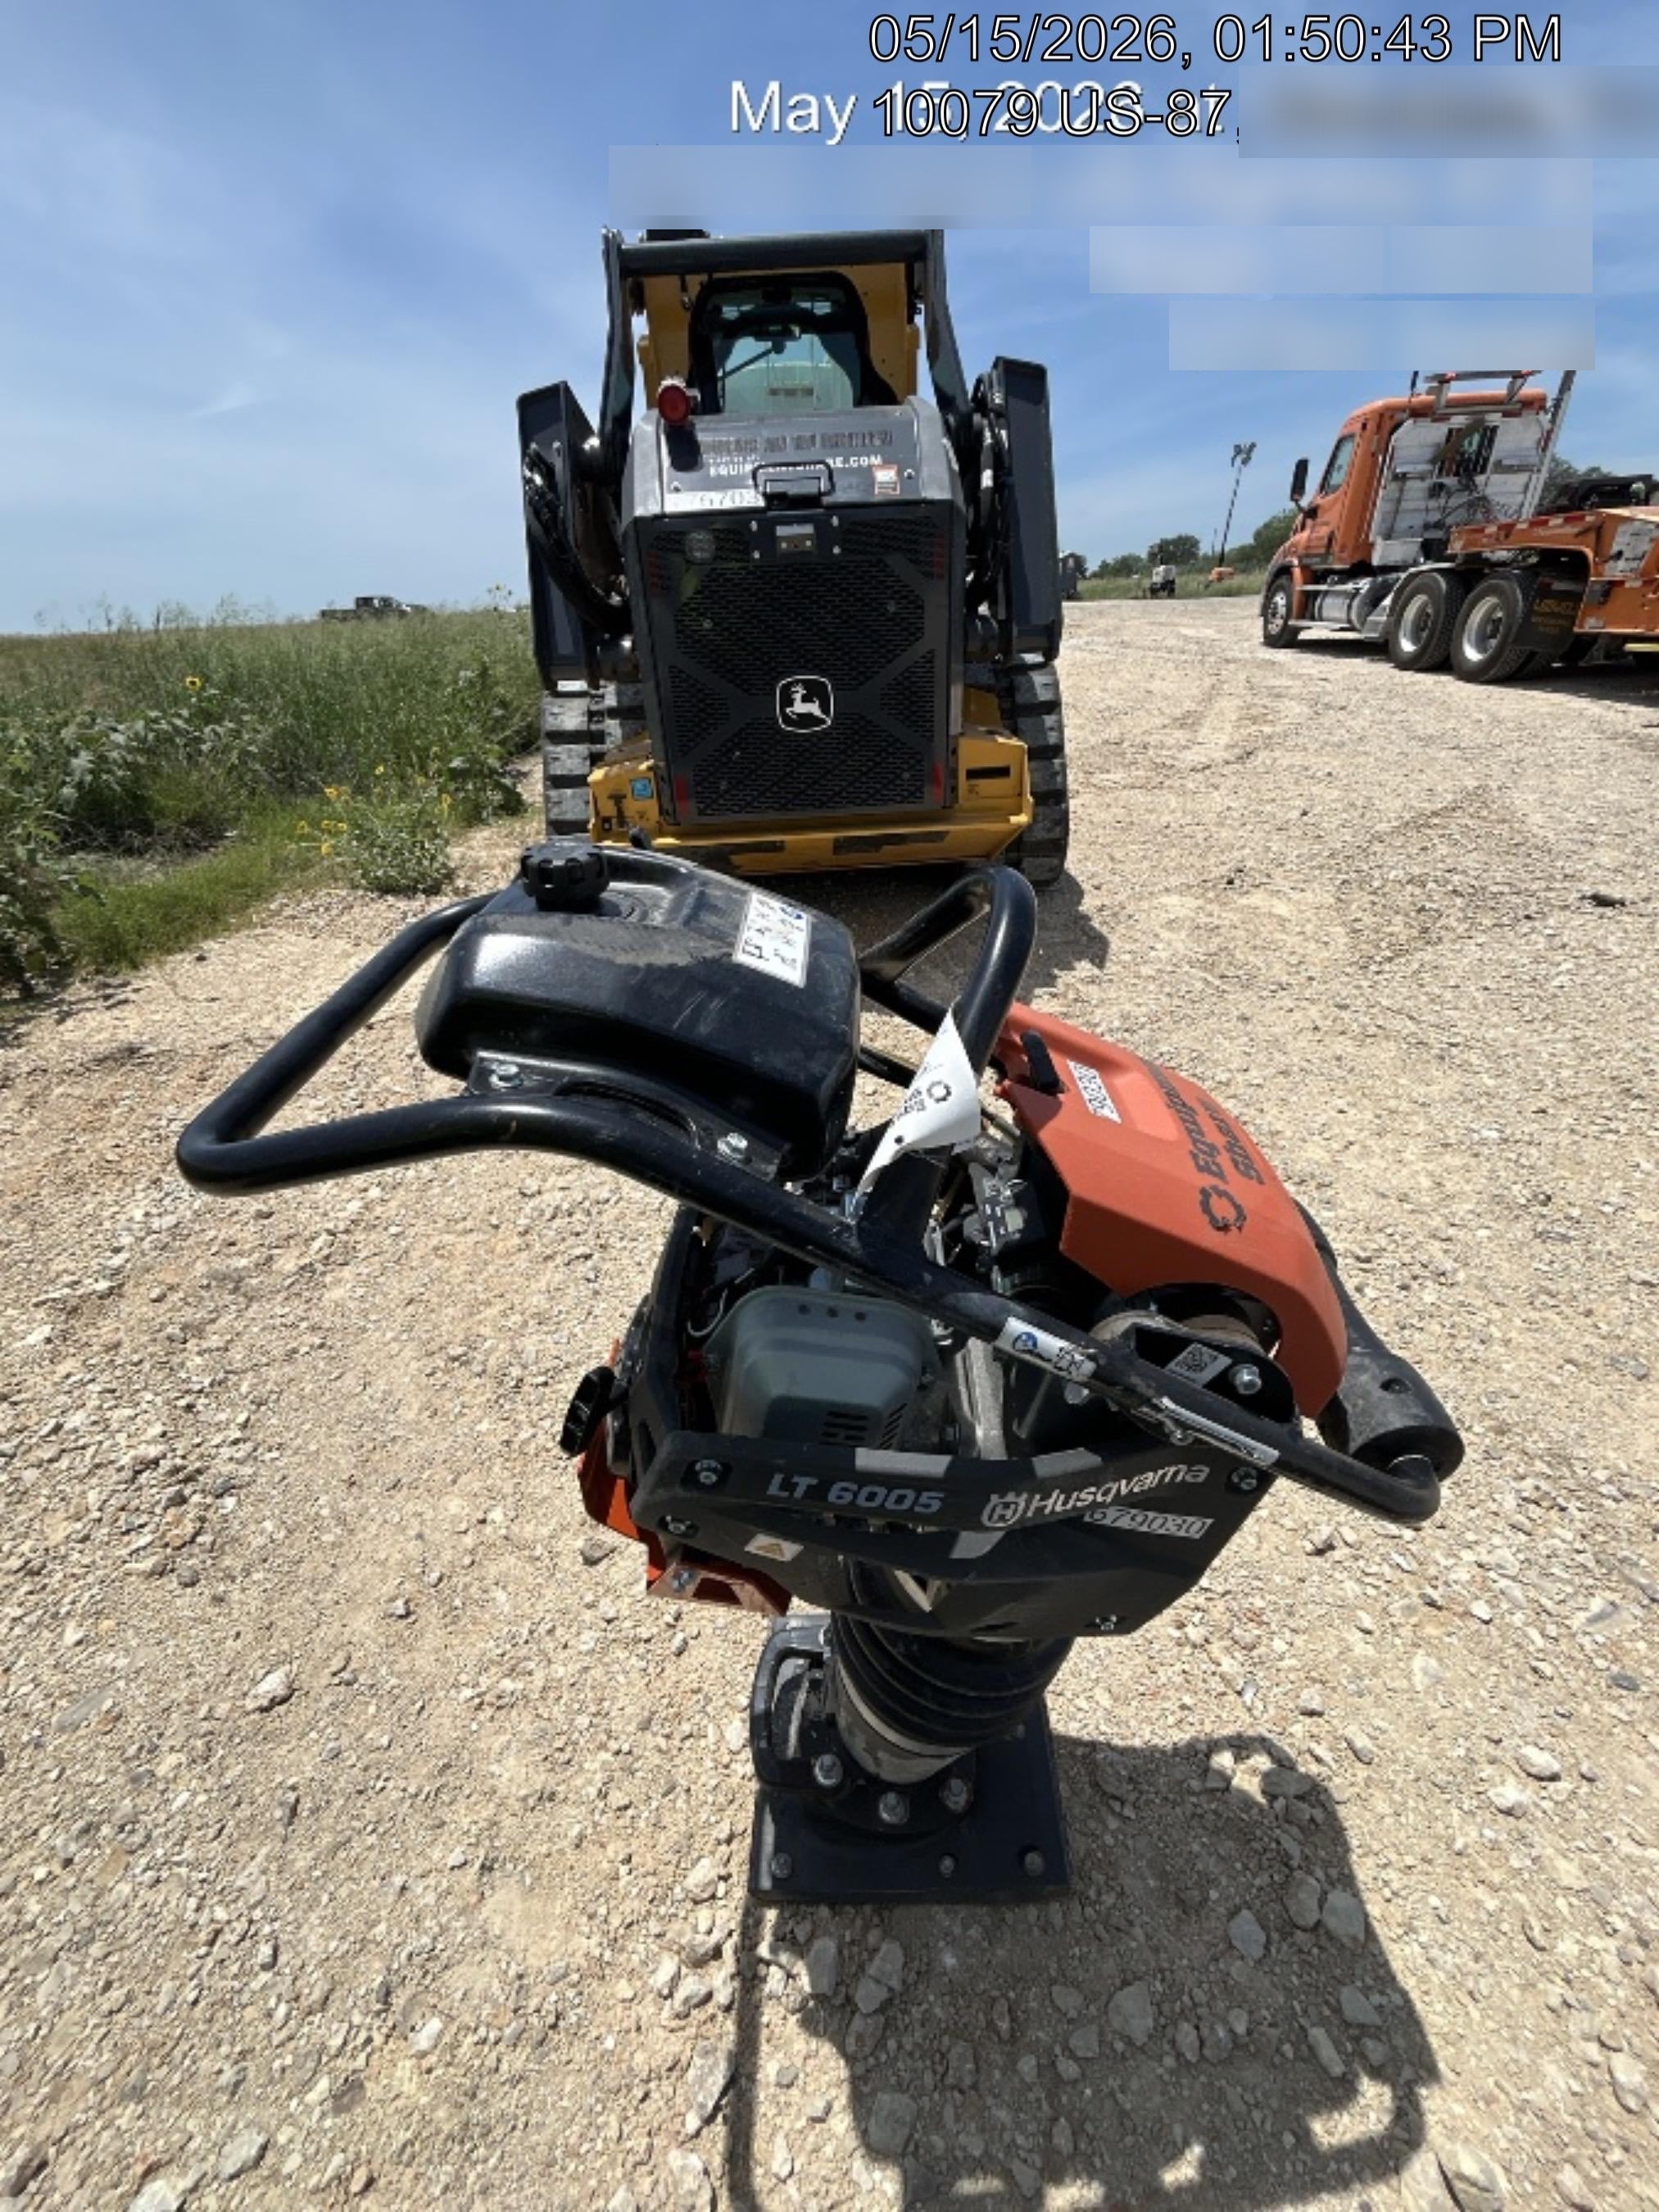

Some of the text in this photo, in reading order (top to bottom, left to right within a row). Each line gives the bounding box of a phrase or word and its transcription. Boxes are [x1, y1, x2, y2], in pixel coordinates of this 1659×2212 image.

[767, 1472, 946, 1514] LT 6005
[1027, 1463, 1210, 1518] Husqvarna
